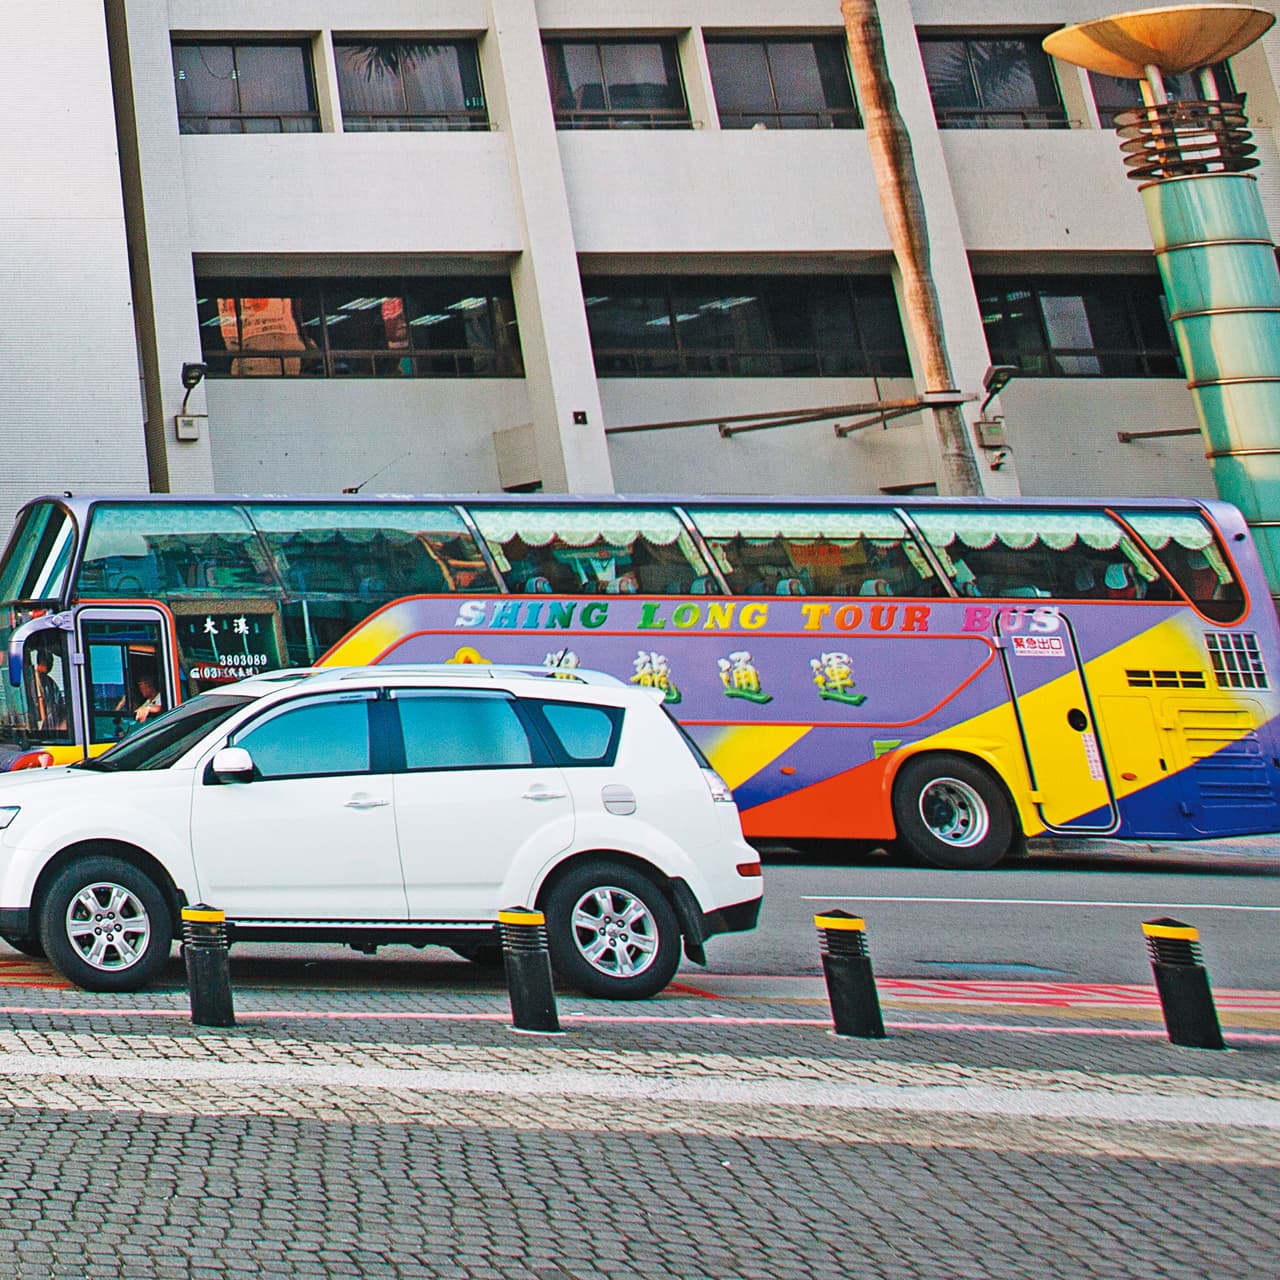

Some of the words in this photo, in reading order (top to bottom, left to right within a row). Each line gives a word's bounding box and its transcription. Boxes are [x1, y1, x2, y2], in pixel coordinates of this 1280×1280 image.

[454, 601, 609, 630] SHING
[637, 602, 771, 631] LONG
[802, 604, 932, 632] TOUR
[961, 606, 1062, 633] BUS
[1012, 637, 1062, 649] 緊急出口
[220, 654, 268, 666] 3803089
